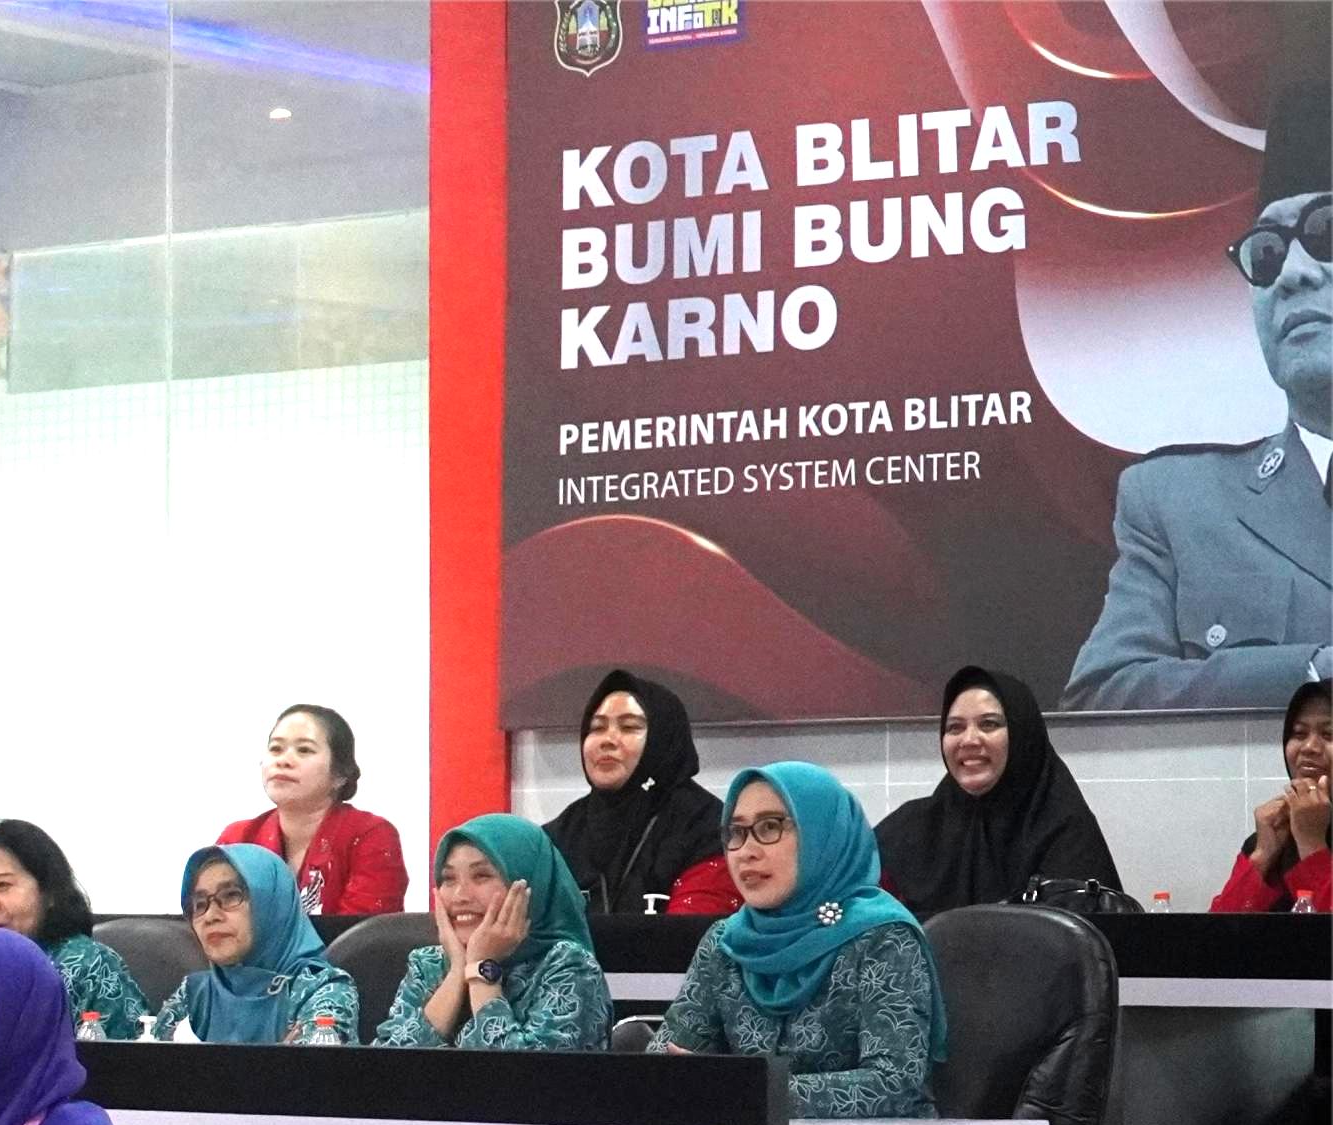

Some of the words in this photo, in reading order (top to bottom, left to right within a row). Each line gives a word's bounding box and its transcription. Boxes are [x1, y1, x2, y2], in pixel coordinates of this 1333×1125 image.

[562, 130, 769, 211] KOTA
[796, 100, 1082, 186] BLITAR
[562, 209, 762, 290] BUMI
[794, 187, 1026, 268] BUNG
[561, 284, 838, 369] KARNO
[559, 407, 788, 456] PEMERINTAH
[799, 400, 894, 437] KOTA
[905, 390, 1032, 431] BLITAR
[558, 466, 735, 505] INTEGRATED
[743, 458, 856, 493] SYSTEM
[866, 450, 981, 485] CENTER
